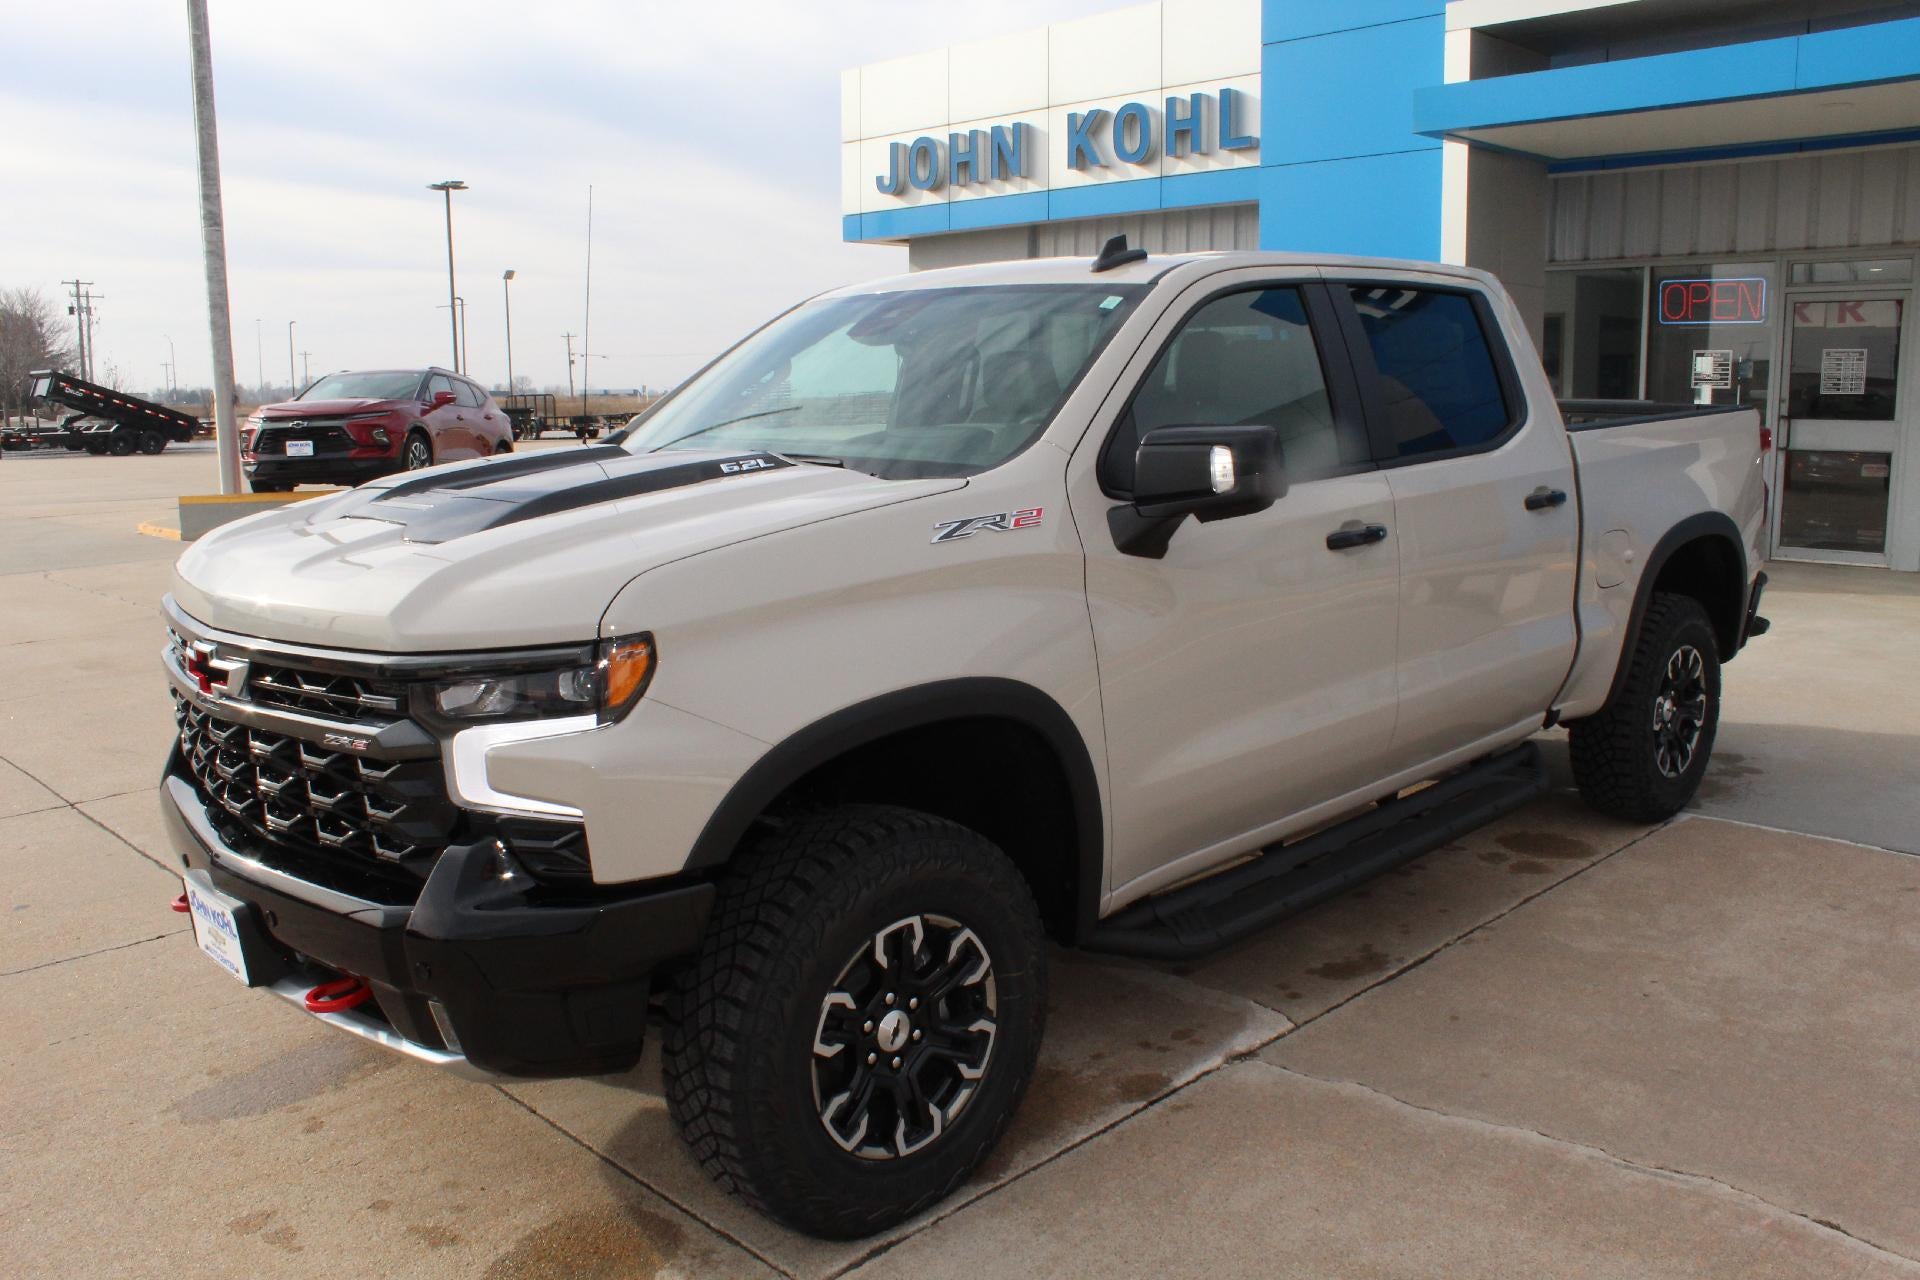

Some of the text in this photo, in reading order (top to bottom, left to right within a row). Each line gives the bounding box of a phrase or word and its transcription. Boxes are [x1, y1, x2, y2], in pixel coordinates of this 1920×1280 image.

[875, 87, 1260, 196] JOHN KOHL
[1664, 282, 1762, 320] OPEN
[930, 507, 1044, 544] ZR2
[324, 733, 371, 750] ZR2
[190, 891, 237, 938] JOHN KOHL
